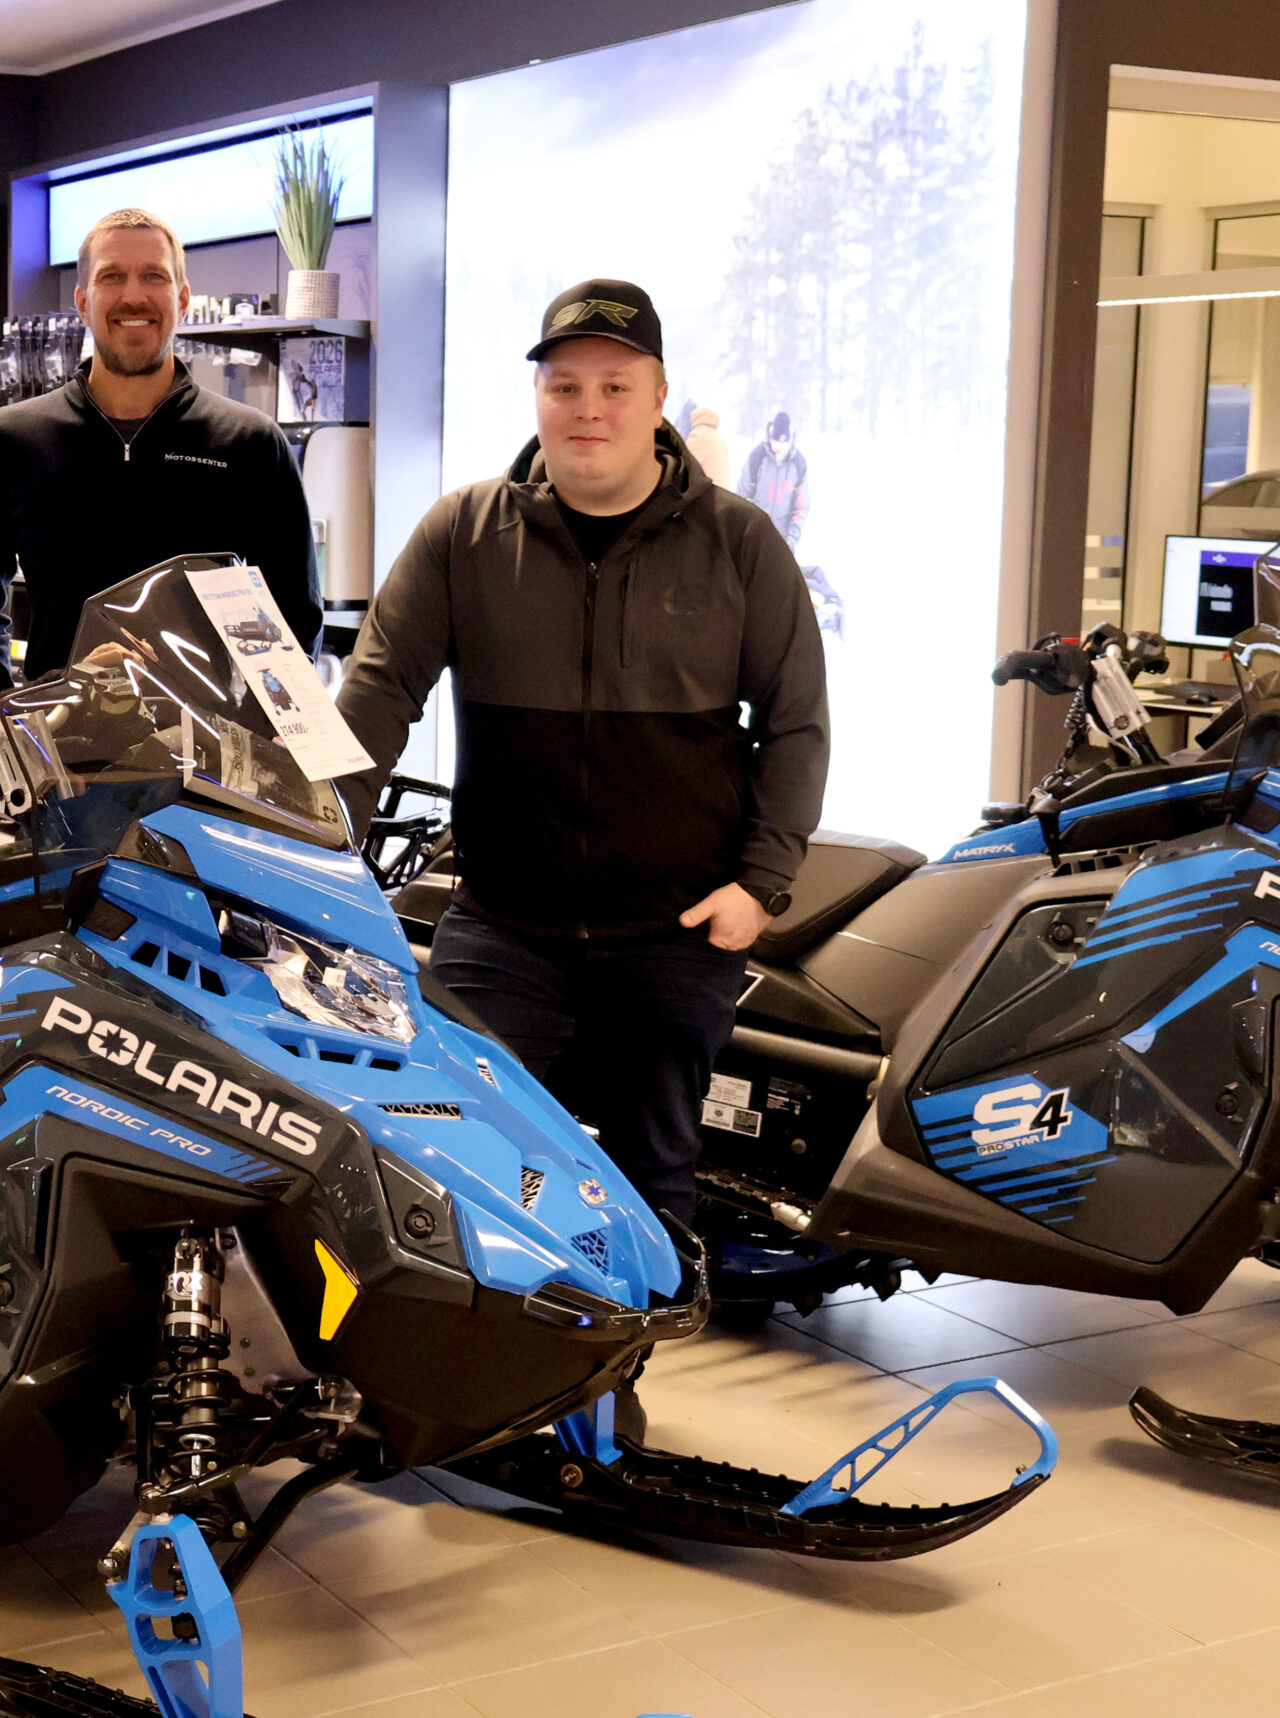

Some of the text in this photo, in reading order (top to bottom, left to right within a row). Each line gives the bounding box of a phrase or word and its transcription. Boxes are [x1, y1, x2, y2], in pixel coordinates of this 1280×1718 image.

[309, 339, 343, 364] 2026
[164, 452, 228, 469] MOTORSENTER
[952, 843, 1016, 861] MATRYX
[40, 996, 323, 1156] POLARIS
[45, 1085, 213, 1156] NORDIC PRO
